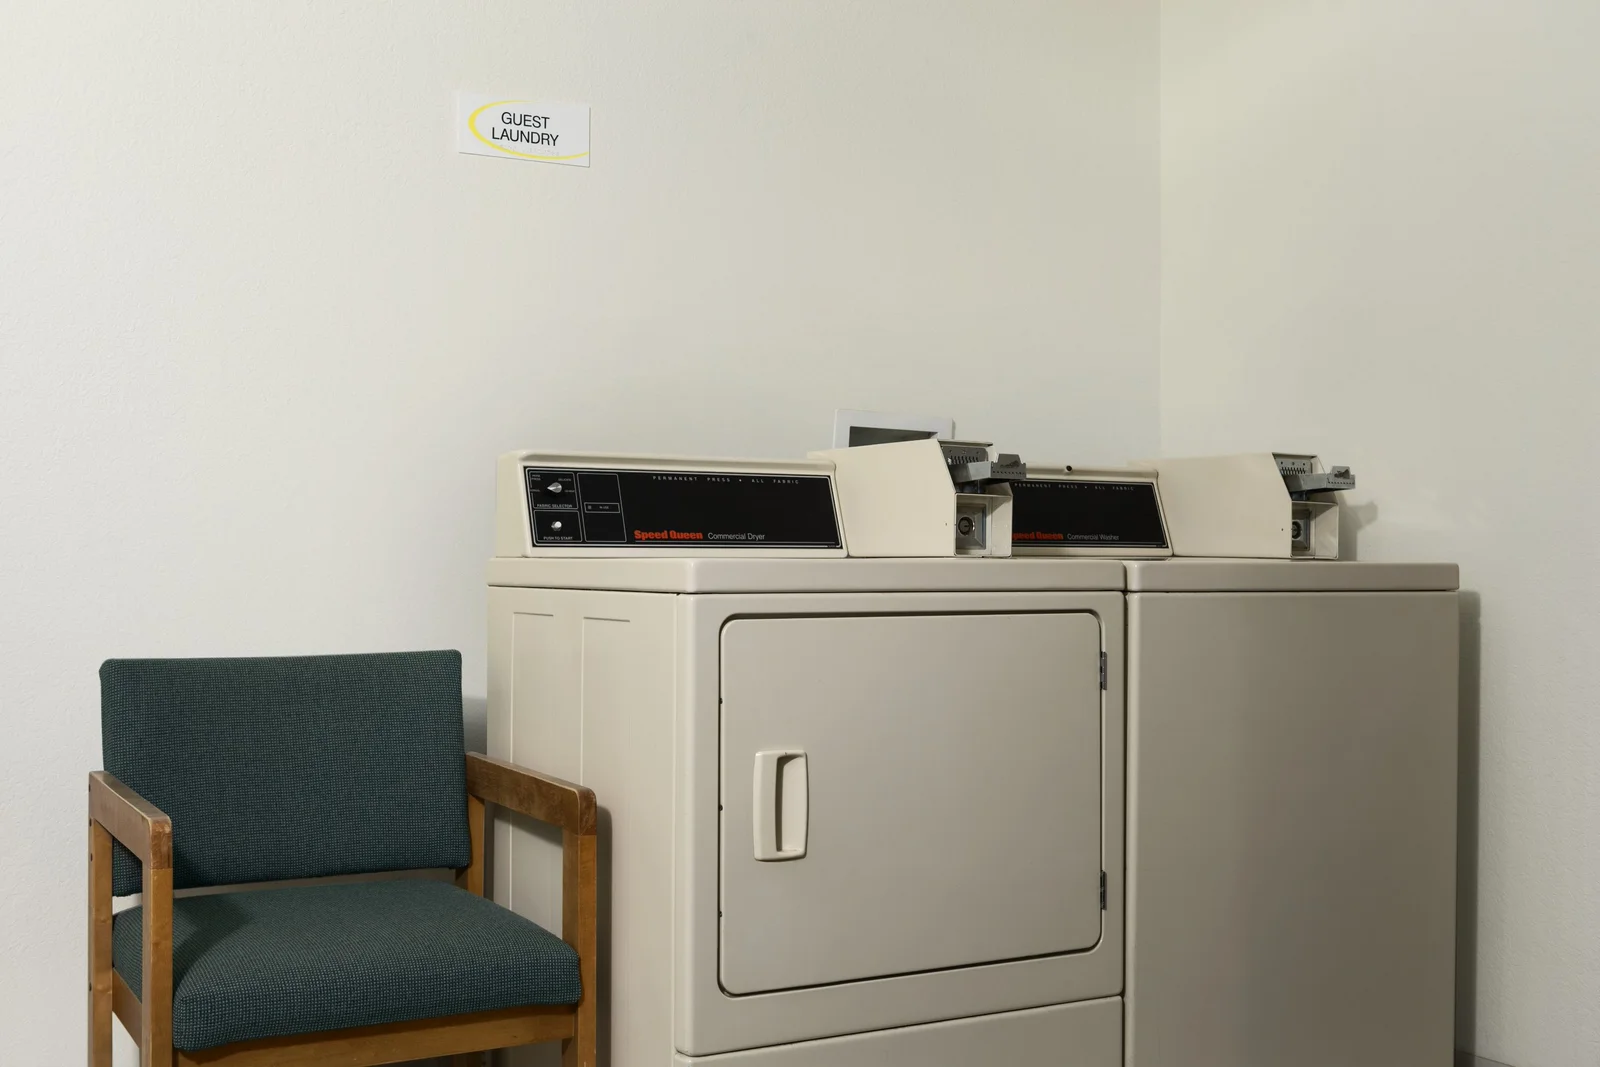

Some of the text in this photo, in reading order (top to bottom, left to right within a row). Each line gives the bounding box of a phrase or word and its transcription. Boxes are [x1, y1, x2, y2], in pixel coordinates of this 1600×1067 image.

[501, 111, 550, 129] GUEST
[492, 127, 559, 146] LAUNDRY
[634, 530, 766, 541] Speed Queen Commercial Dryer
[1012, 532, 1035, 540] peed
[1036, 532, 1064, 540] Queen
